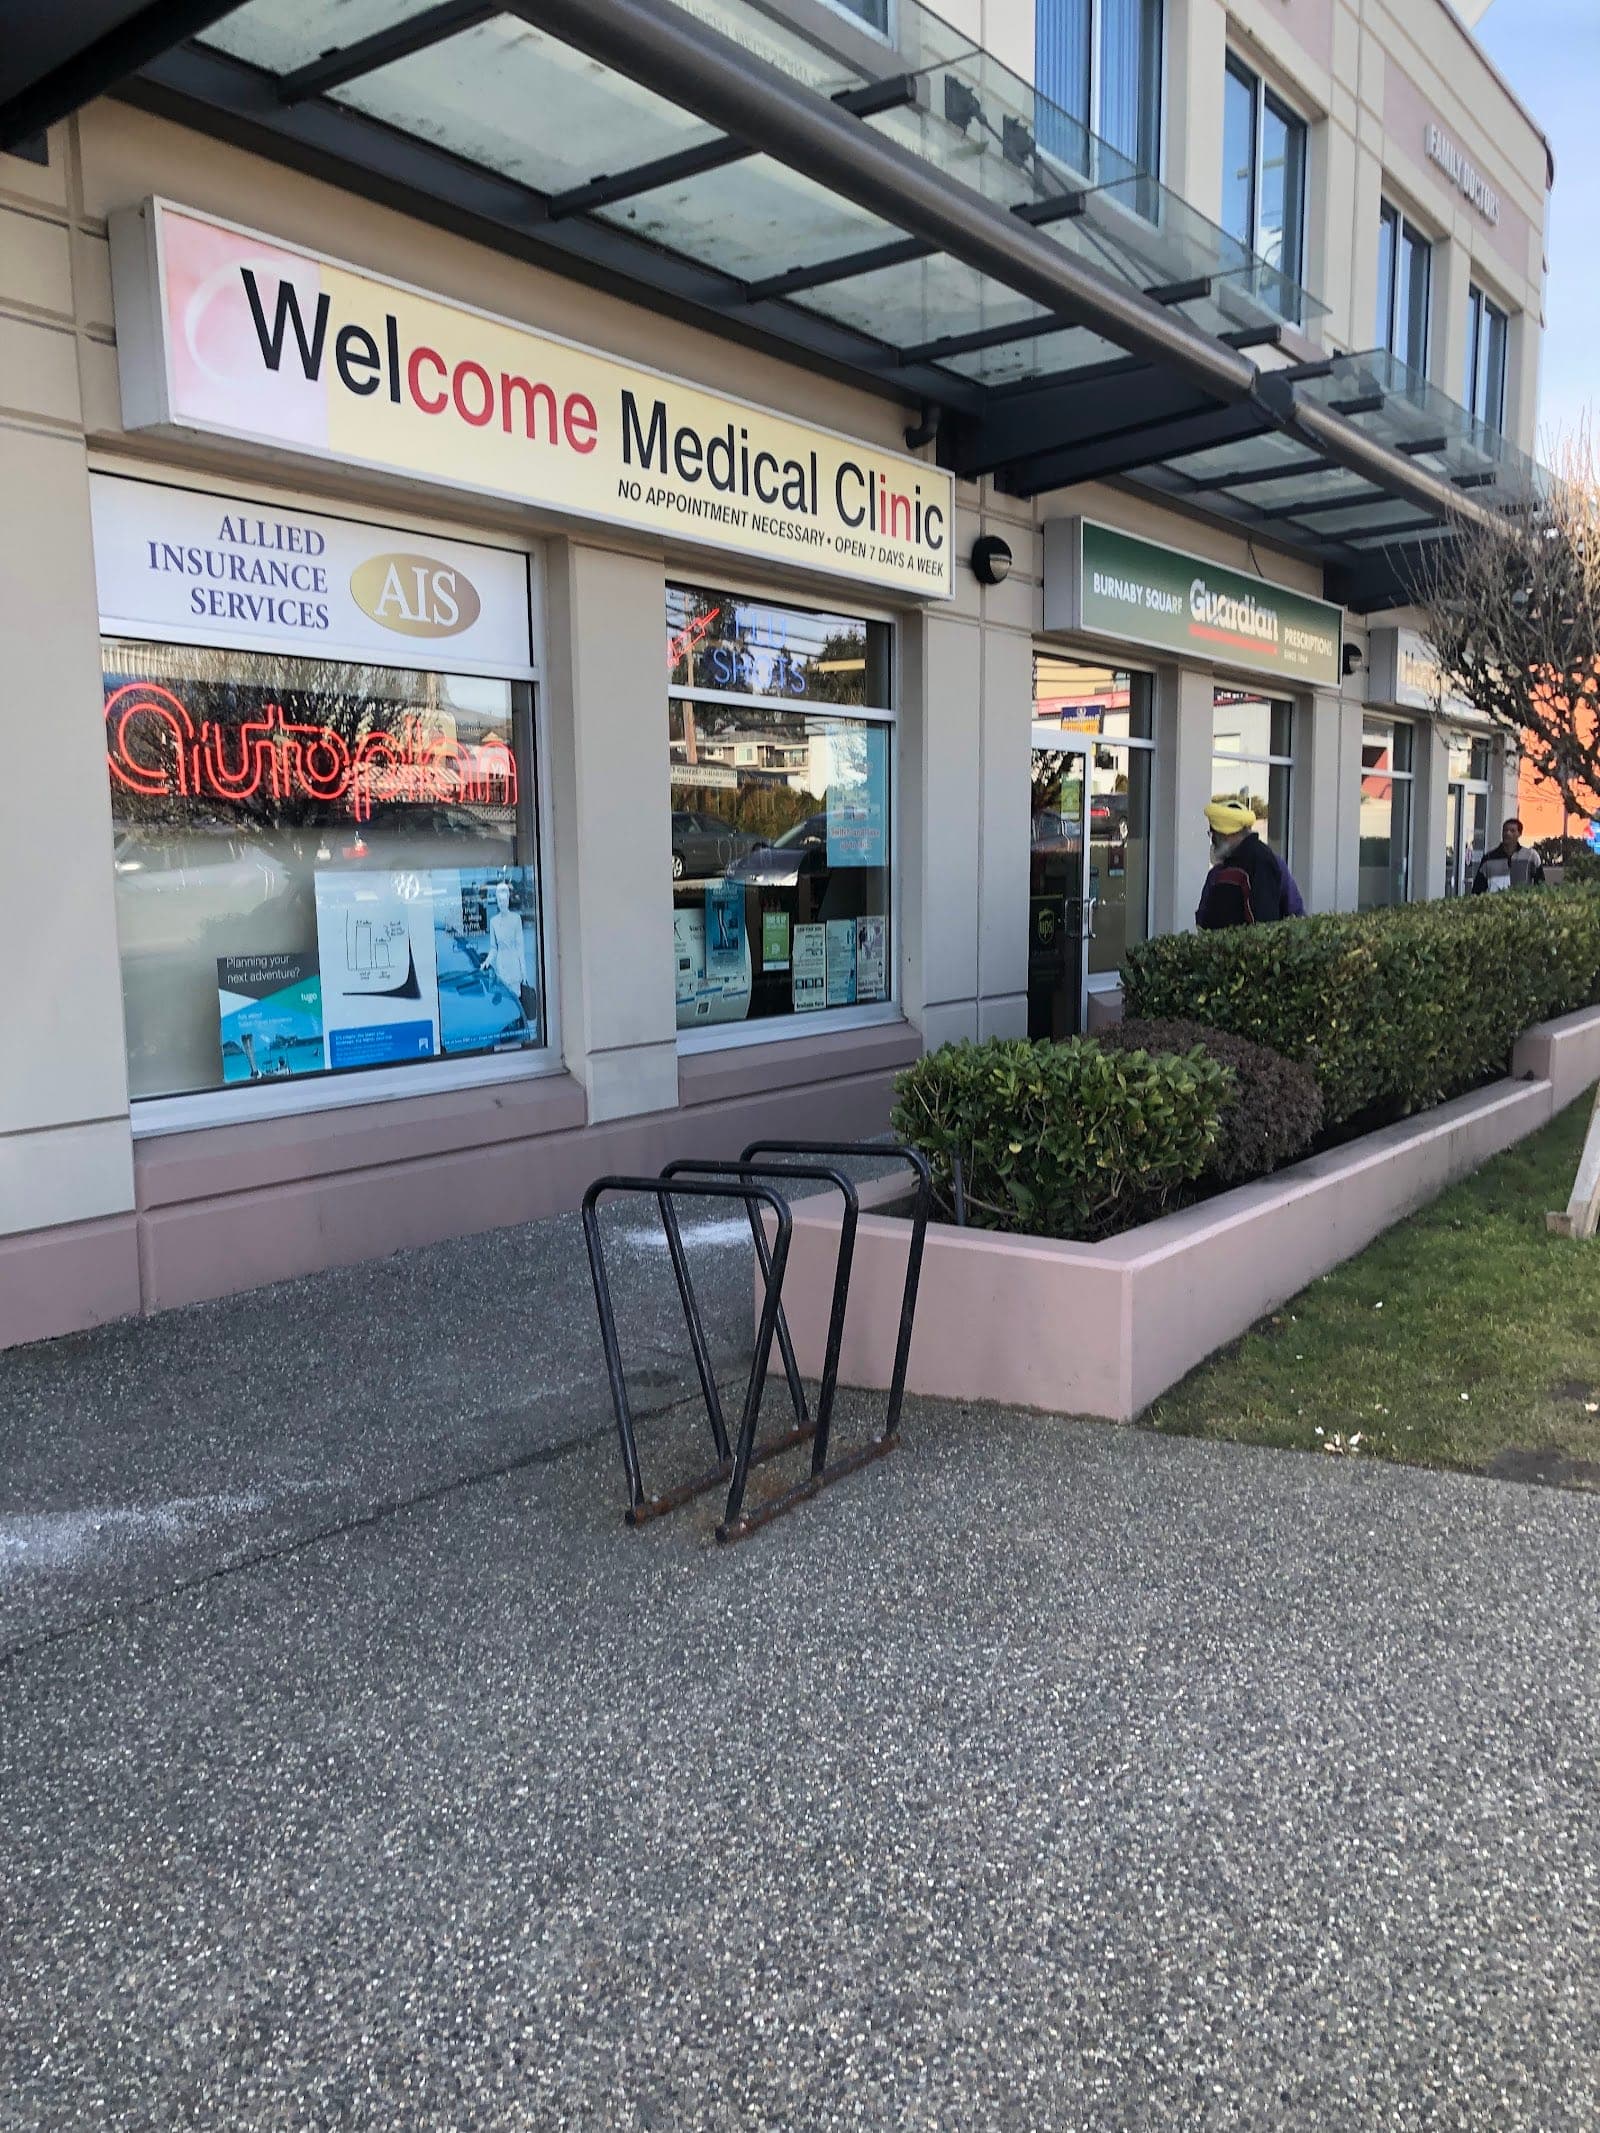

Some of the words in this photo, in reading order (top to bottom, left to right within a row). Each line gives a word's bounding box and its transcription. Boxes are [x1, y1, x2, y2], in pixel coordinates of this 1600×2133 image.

[1427, 122, 1464, 184] FAMILY
[1463, 161, 1499, 226] DOCTORS
[239, 266, 599, 455] Welcome
[621, 389, 818, 516] Medical
[835, 461, 944, 551] Clinic
[218, 514, 326, 557] ALLIED
[618, 479, 642, 501] NO
[645, 487, 749, 528] APPOINTMENT
[752, 512, 825, 547] NECESSARY
[835, 536, 867, 560] OPEN
[869, 545, 877, 560] 7
[878, 547, 905, 569] DAYS
[906, 555, 914, 571] A
[917, 556, 945, 578] WEEK
[147, 541, 329, 594] INSURANCE
[190, 588, 330, 630] SERVICES
[373, 562, 460, 626] AIS
[1093, 572, 1144, 605] BURNABY
[1145, 587, 1183, 615] SQUARE
[1189, 578, 1279, 642] Guardian
[734, 606, 786, 648] FLU
[713, 648, 806, 693] SHOTS
[226, 956, 268, 969] Planning
[269, 954, 291, 968] your
[227, 972, 248, 985] next
[250, 966, 301, 982] adventure?
